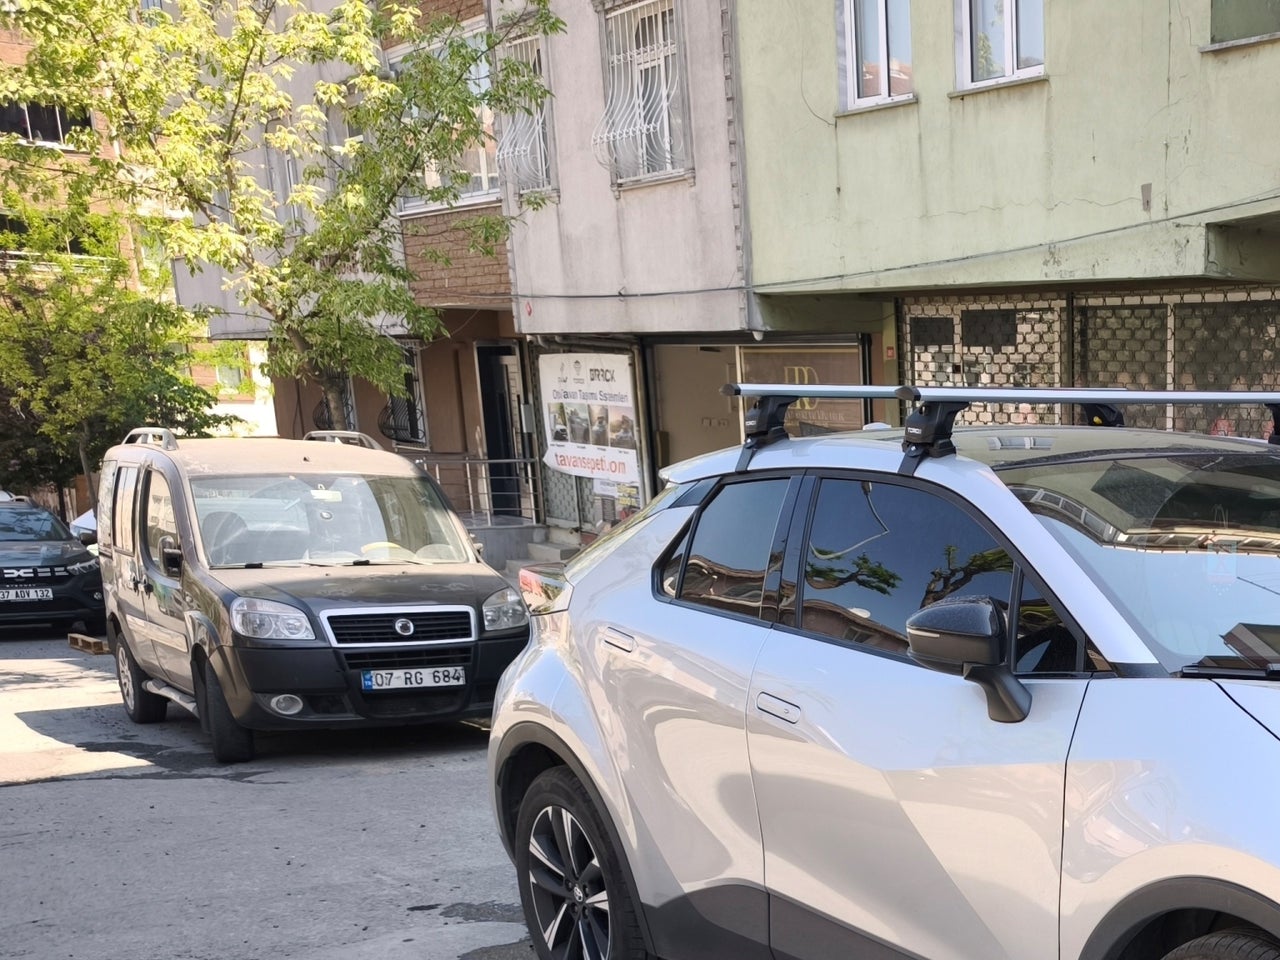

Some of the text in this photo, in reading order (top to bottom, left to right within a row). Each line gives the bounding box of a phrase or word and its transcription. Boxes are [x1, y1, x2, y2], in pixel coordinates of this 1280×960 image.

[375, 669, 462, 687] 07 RG 684
